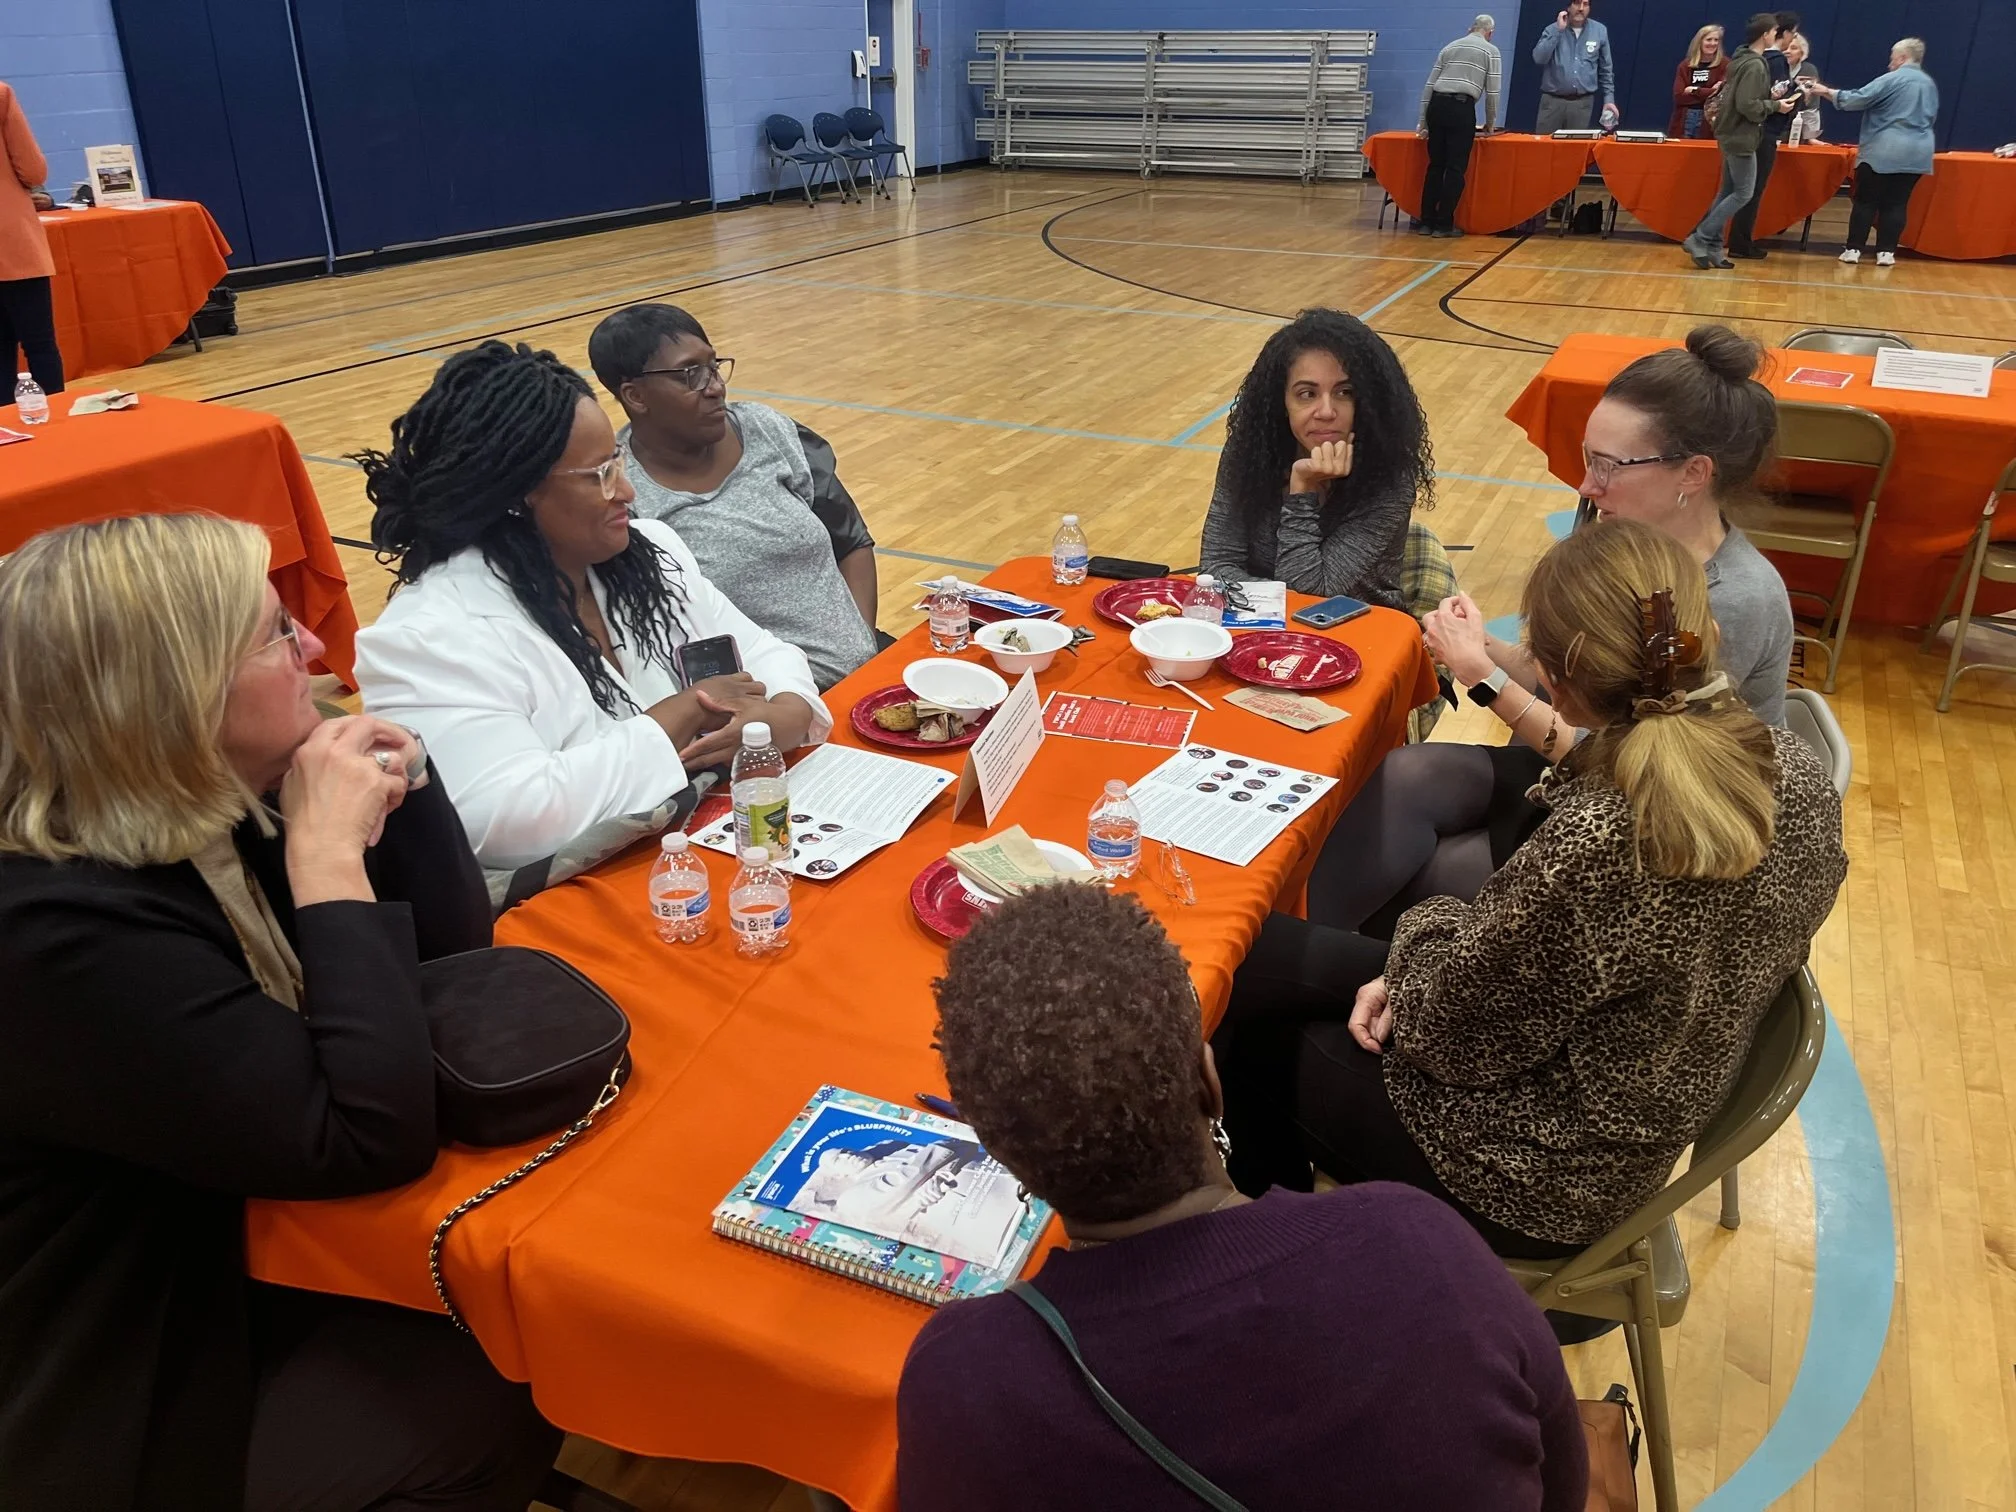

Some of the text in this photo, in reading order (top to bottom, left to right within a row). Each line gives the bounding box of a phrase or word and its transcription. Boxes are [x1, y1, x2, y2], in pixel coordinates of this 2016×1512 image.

[801, 1155, 813, 1173] What
[812, 1135, 830, 1150] your
[828, 1126, 853, 1138] life's
[853, 1123, 913, 1137] BLUEPRINT?
